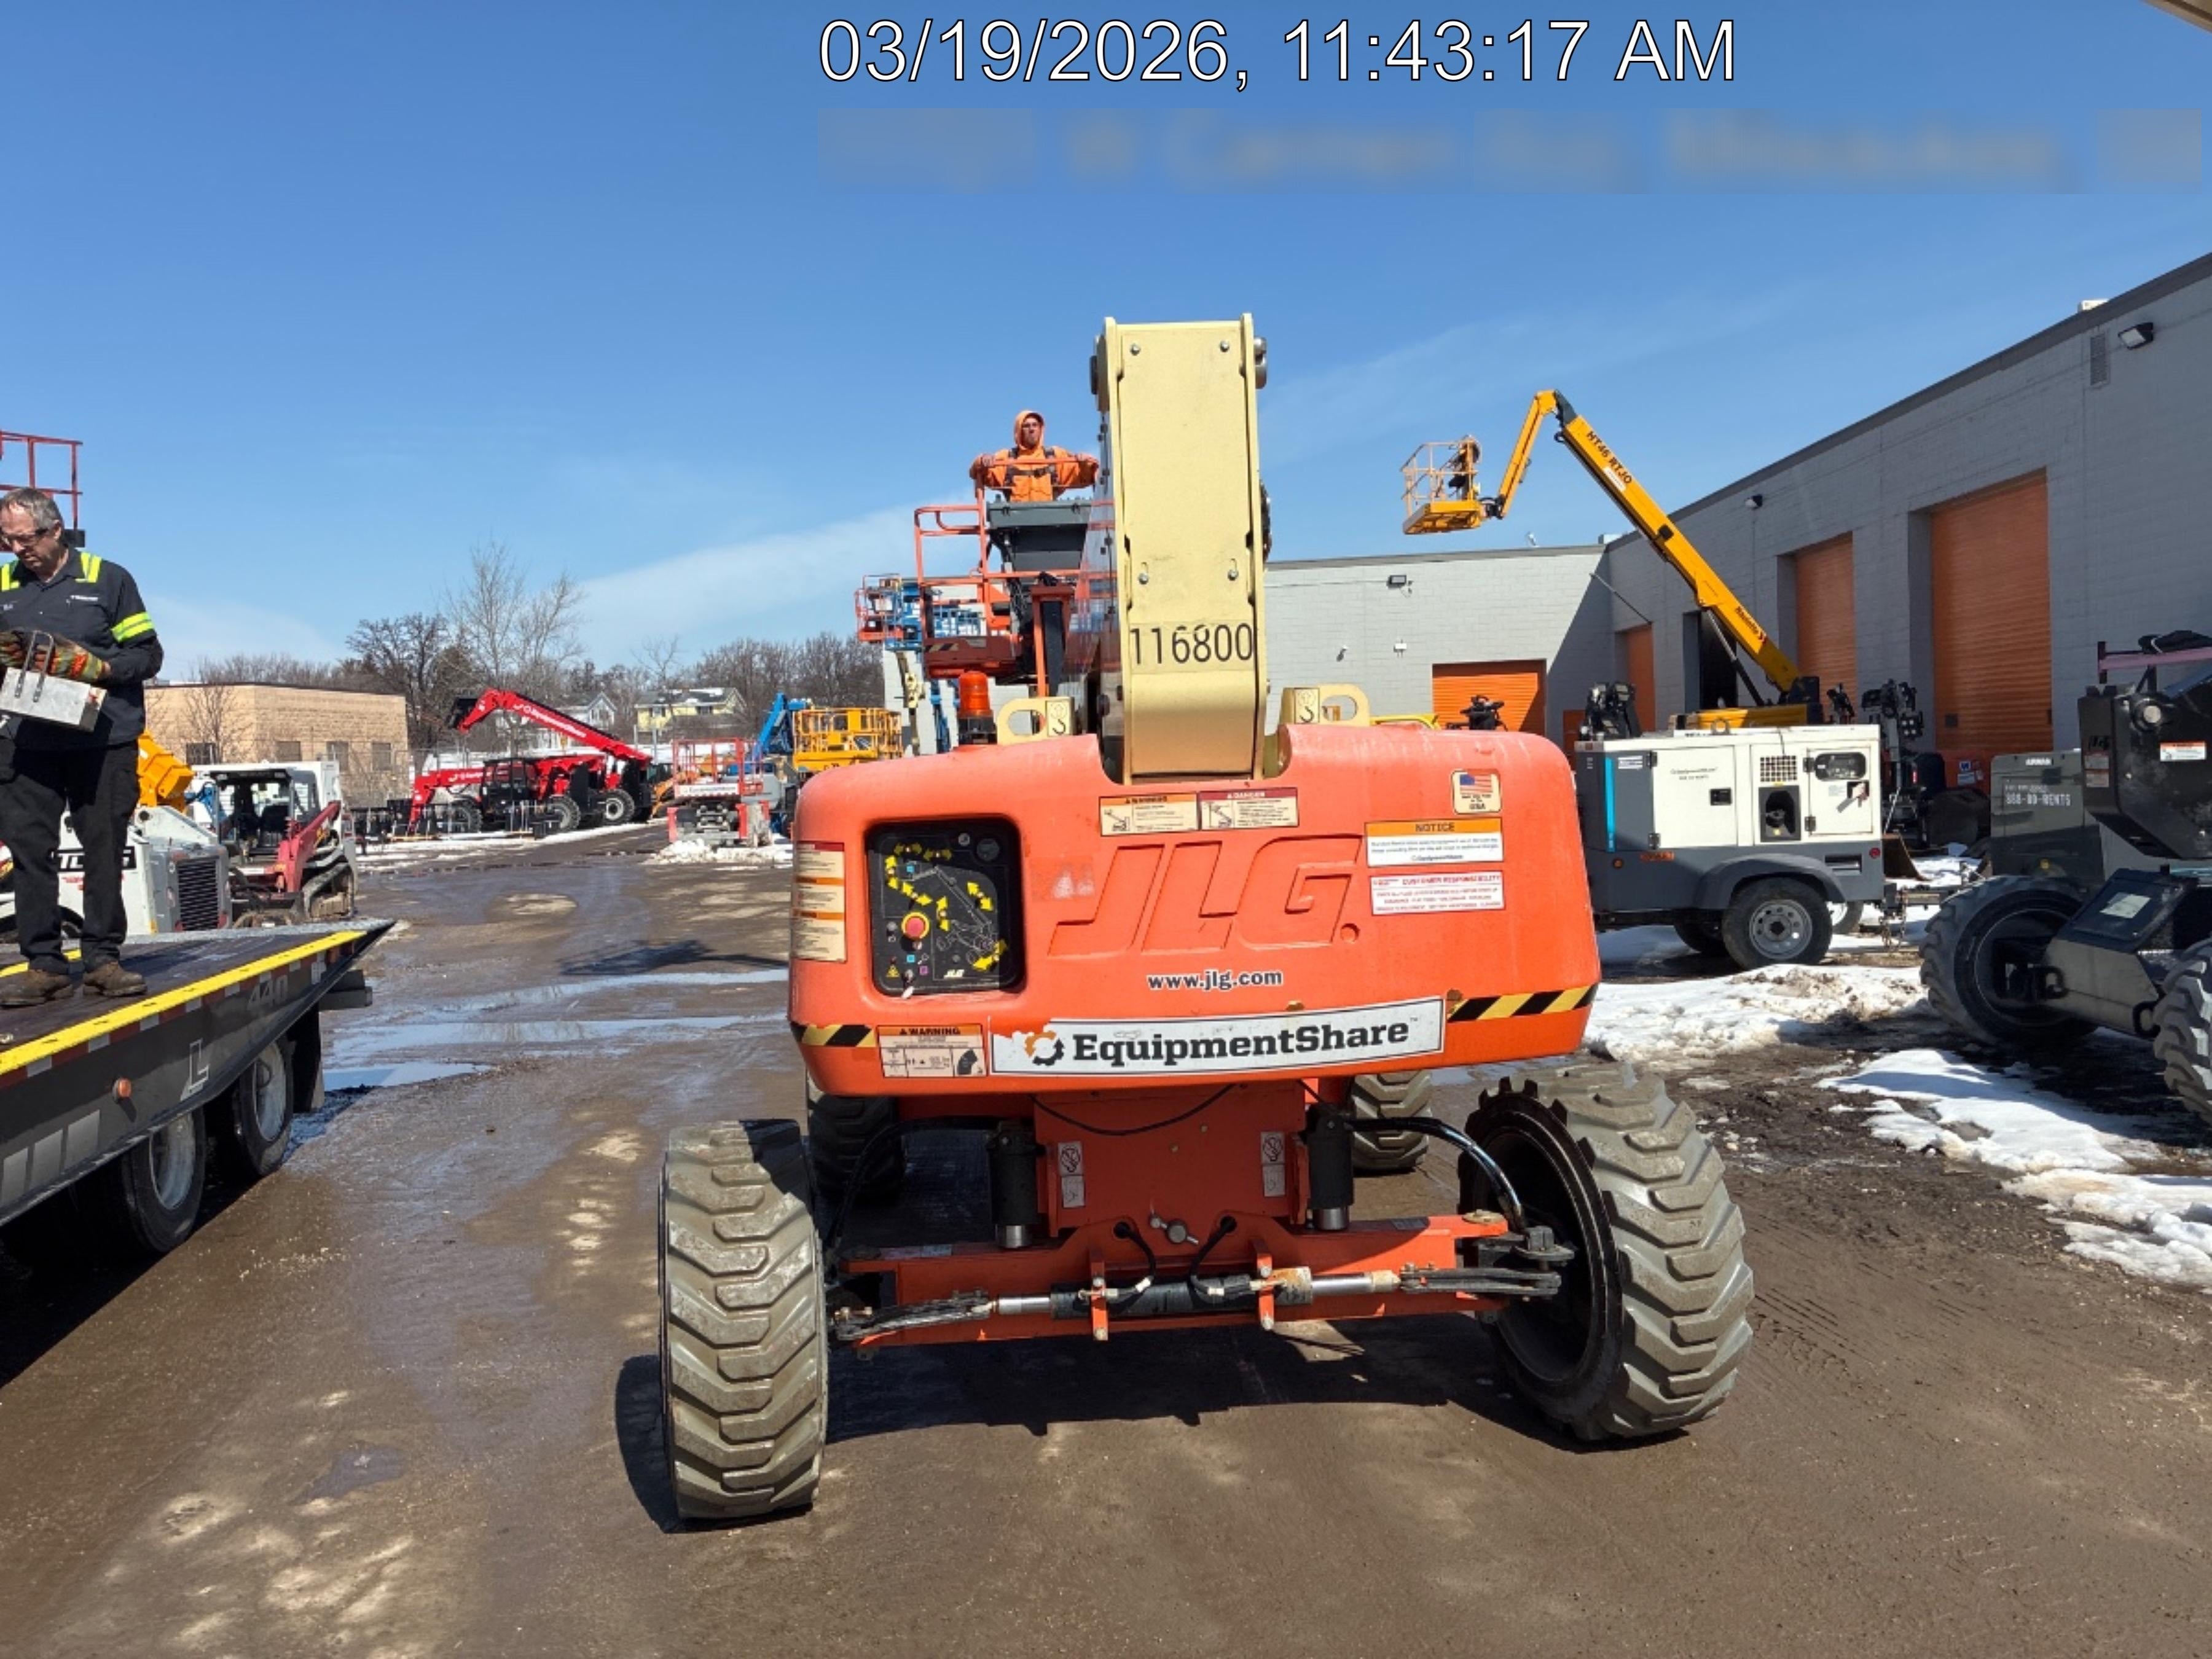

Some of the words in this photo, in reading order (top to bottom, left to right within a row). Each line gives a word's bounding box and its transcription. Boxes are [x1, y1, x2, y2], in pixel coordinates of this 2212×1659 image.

[1129, 622, 1253, 665] 116800
[1415, 822, 1455, 832] NOTICE
[1047, 834, 1363, 959] JLG
[1148, 970, 1282, 990] www.jlg.com
[1073, 1022, 1410, 1067] EquipmentShare
